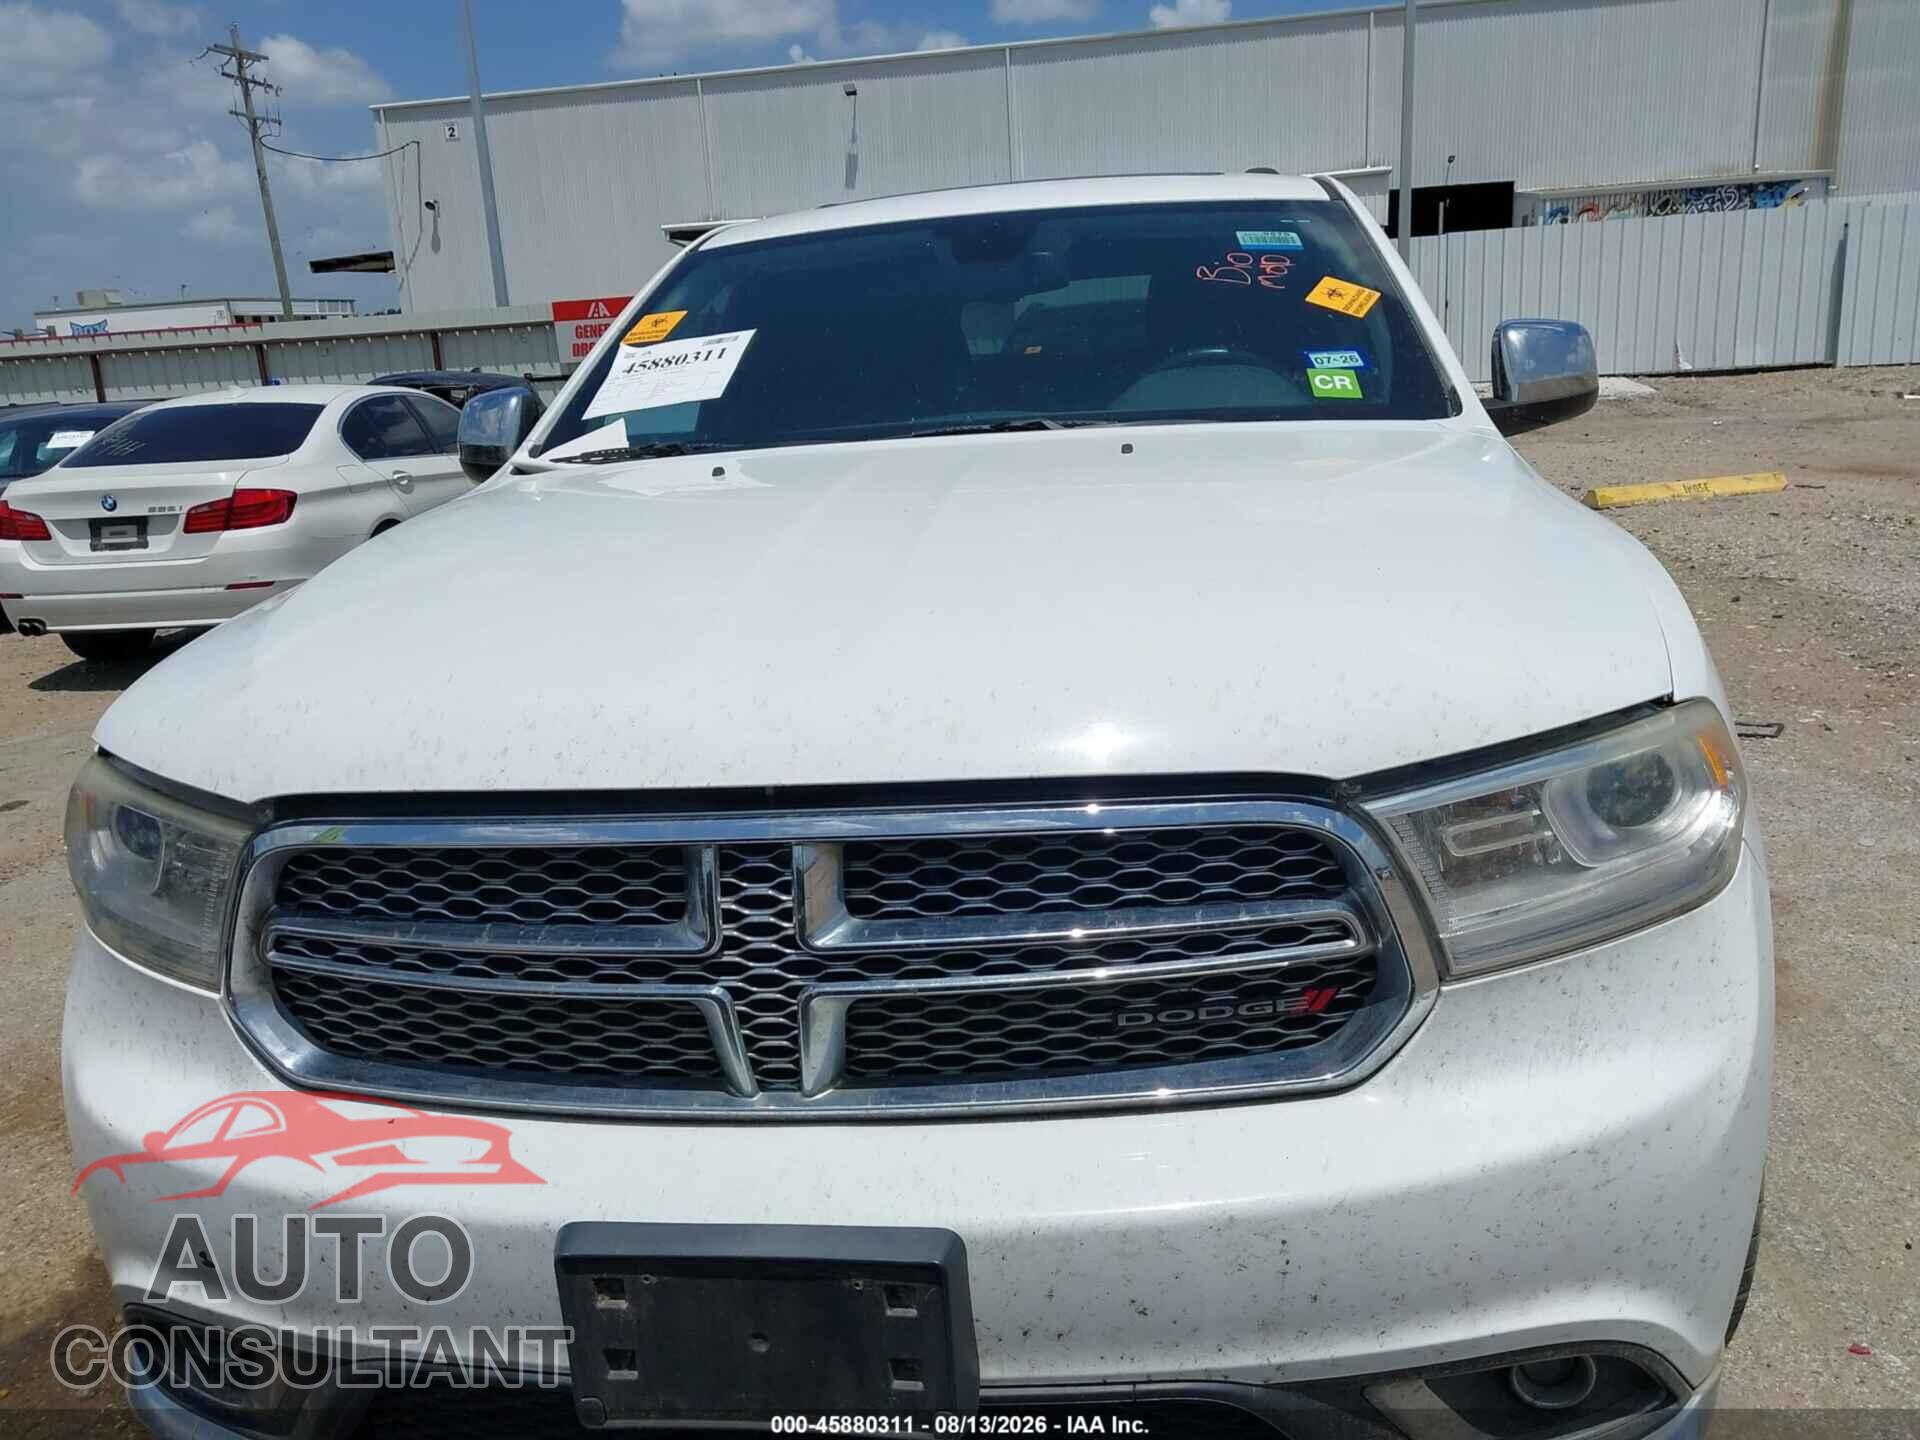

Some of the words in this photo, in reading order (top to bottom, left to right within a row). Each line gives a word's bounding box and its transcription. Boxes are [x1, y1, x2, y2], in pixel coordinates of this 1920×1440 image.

[448, 126, 456, 138] 2
[574, 322, 611, 340] GENE
[622, 347, 727, 374] 45880311
[1314, 375, 1353, 390] CR
[1117, 999, 1309, 1027] DODGE
